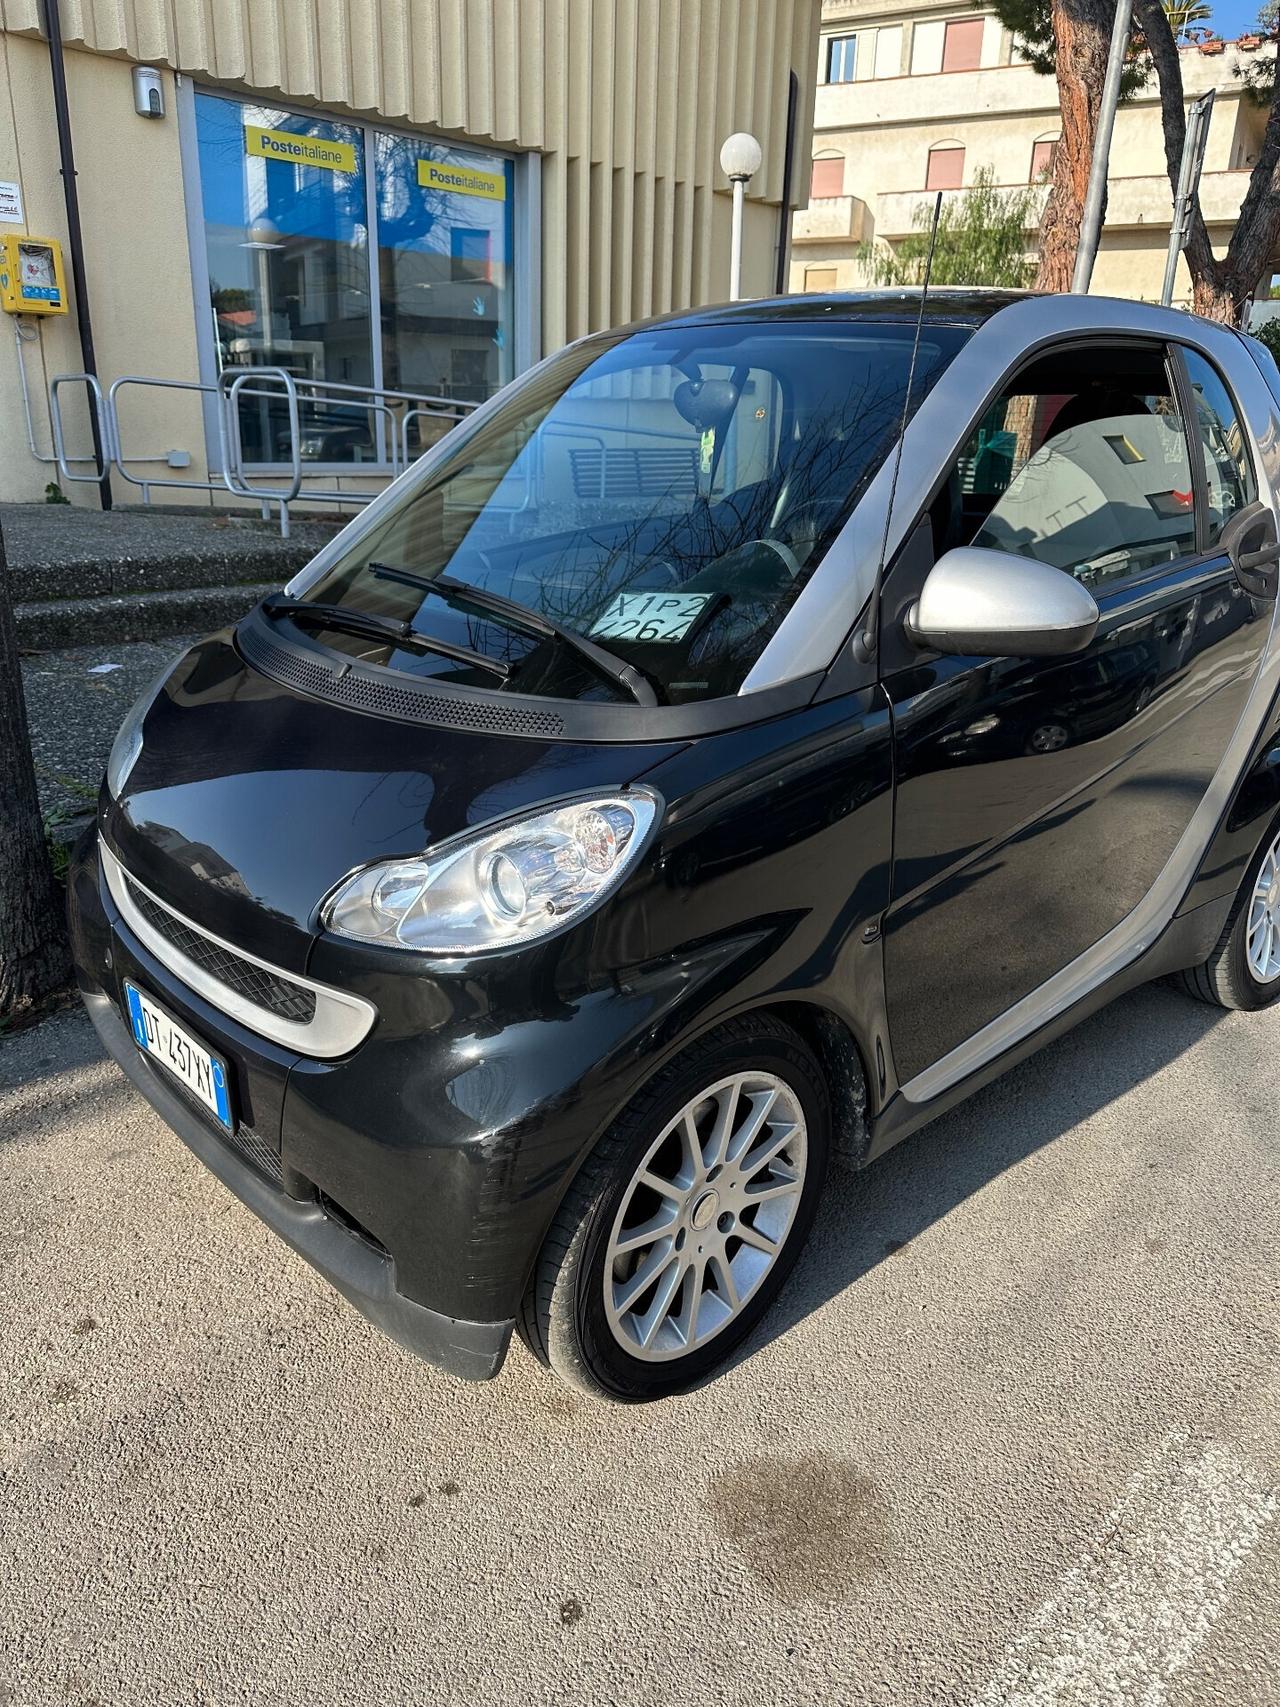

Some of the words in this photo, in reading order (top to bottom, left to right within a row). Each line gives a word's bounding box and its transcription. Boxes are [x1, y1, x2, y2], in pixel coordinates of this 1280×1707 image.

[260, 135, 342, 163] Posteitaliane
[142, 1007, 161, 1051] DT
[168, 1027, 213, 1100] 437XY
